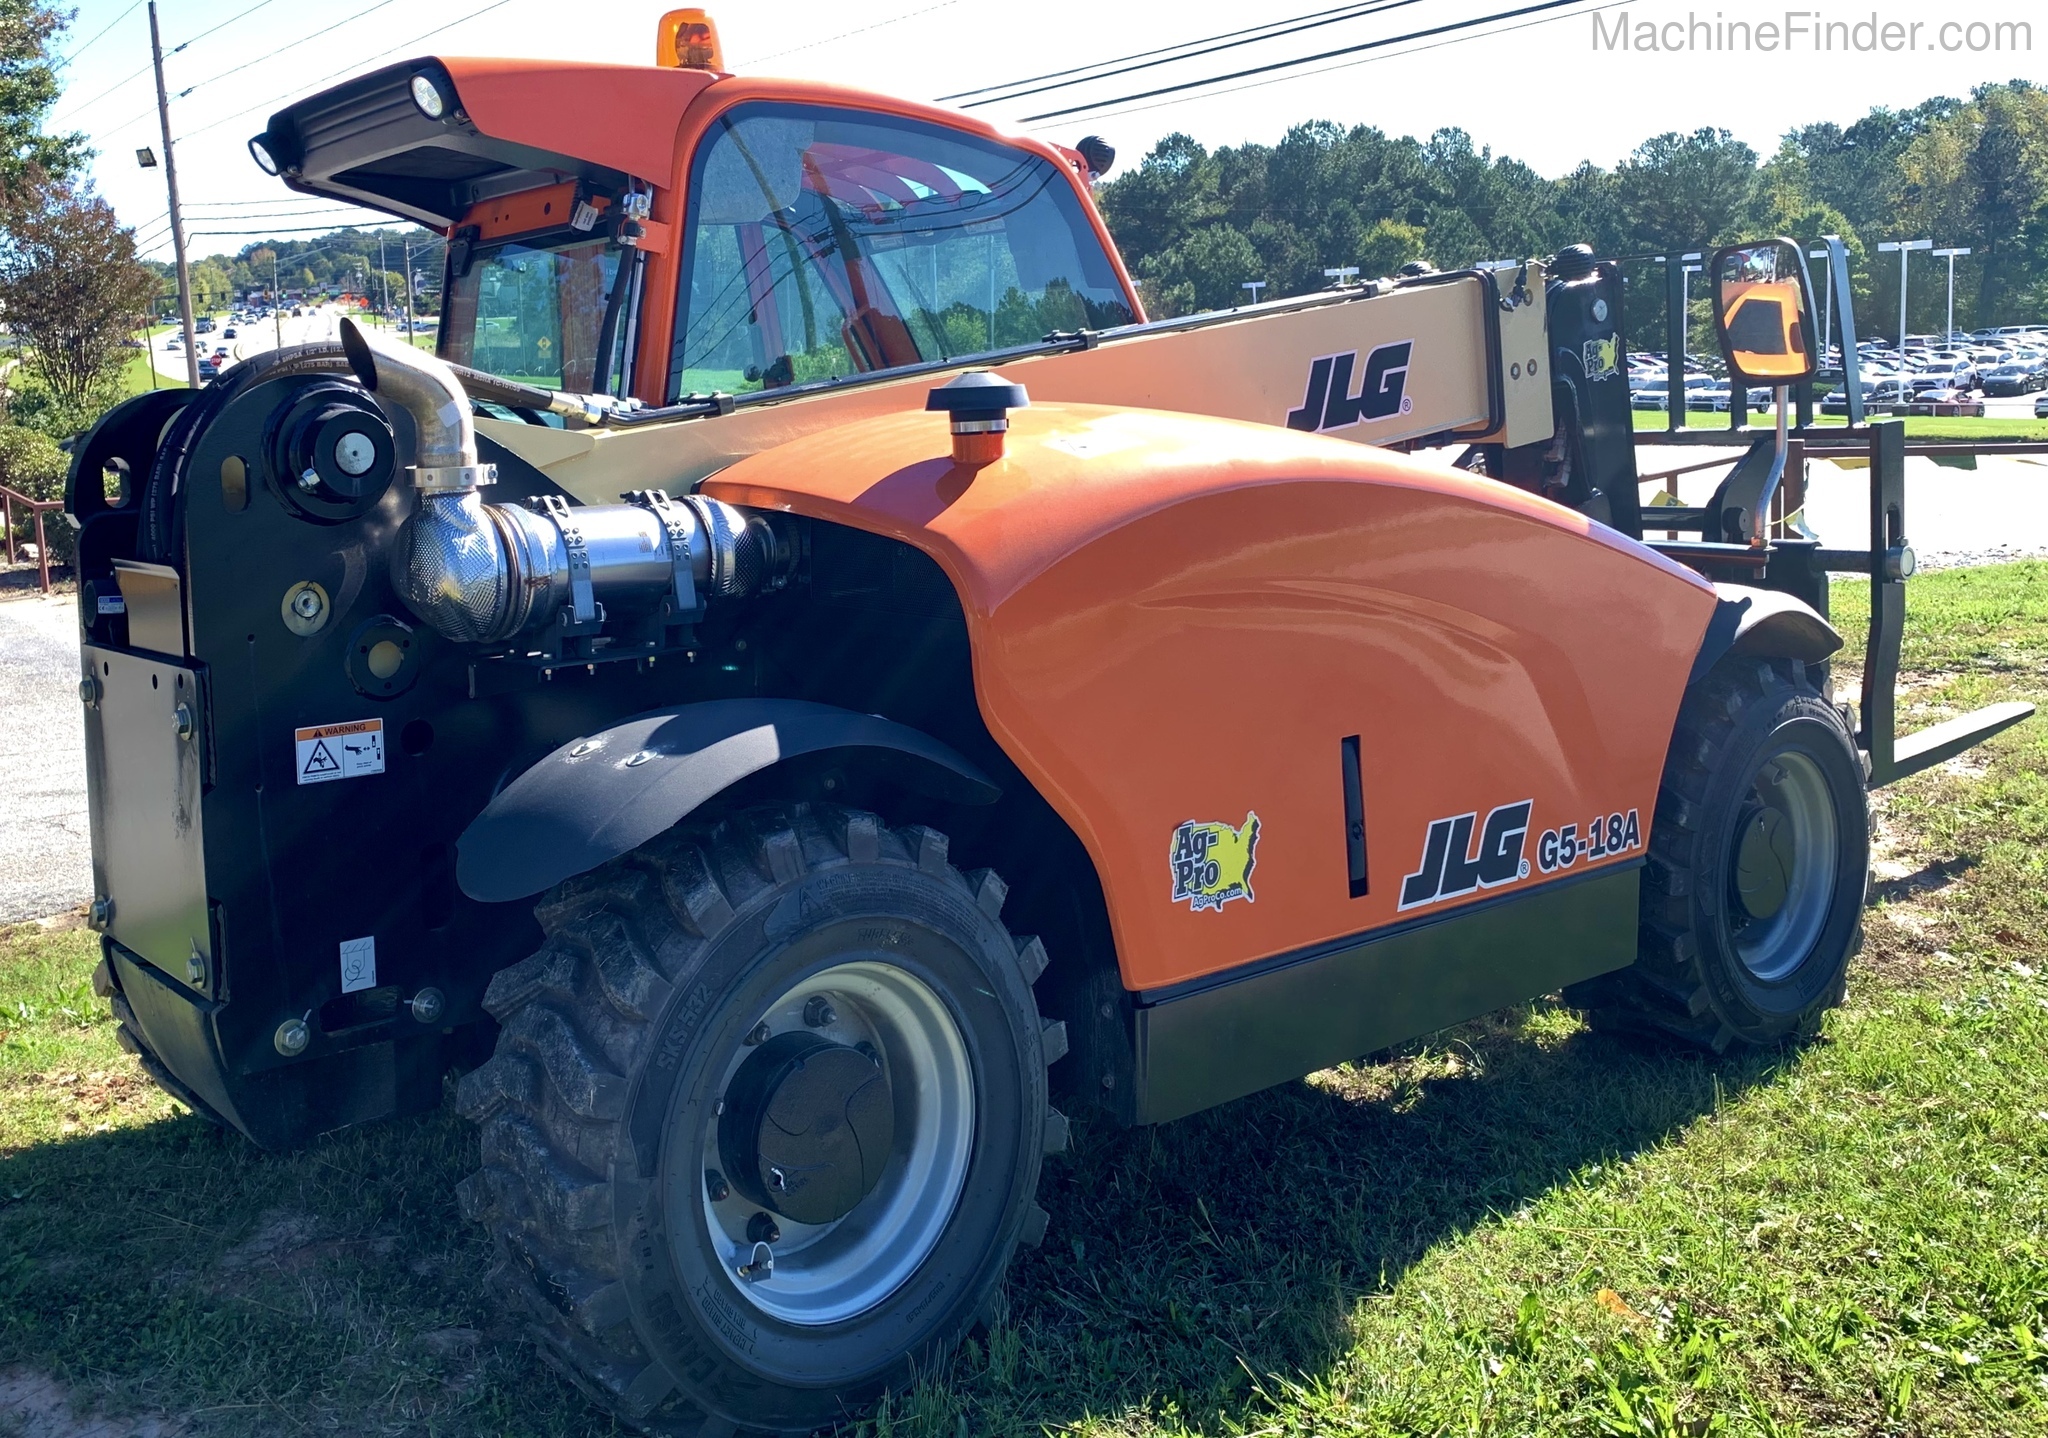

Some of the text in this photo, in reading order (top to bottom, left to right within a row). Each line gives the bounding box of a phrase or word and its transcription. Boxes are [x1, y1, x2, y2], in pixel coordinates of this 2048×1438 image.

[1286, 339, 1413, 432] JLG
[324, 723, 366, 736] WARNING
[1174, 825, 1218, 864] Ag-
[1400, 800, 1641, 910] JLG G5-18A
[1174, 860, 1220, 898] Pro
[1193, 887, 1242, 908] AgProCo.com
[655, 980, 713, 1071] SKS 532
